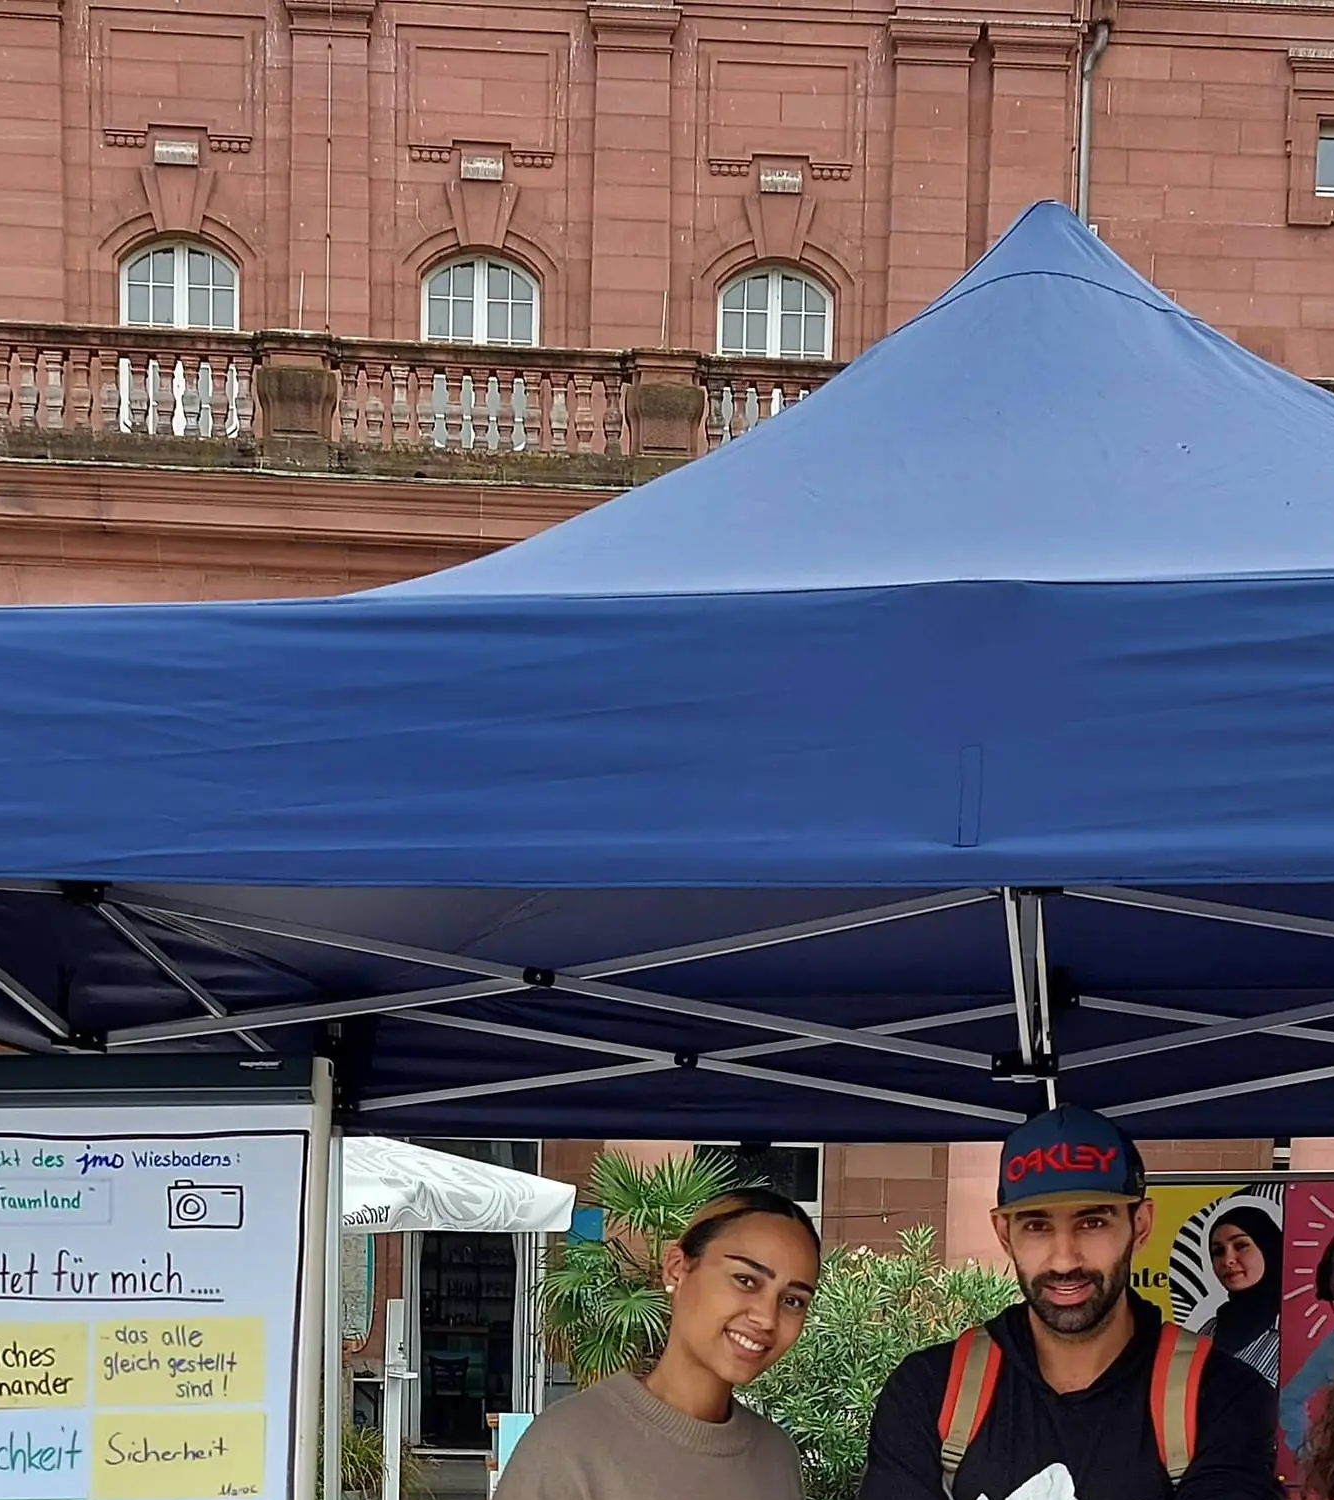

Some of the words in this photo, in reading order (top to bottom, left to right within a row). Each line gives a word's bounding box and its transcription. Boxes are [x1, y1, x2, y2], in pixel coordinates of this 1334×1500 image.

[32, 1149, 64, 1167] des
[1006, 1143, 1117, 1183] OAKLEY
[53, 1250, 96, 1295] für
[115, 1326, 148, 1344] das
[162, 1325, 202, 1347] alle
[104, 1352, 160, 1378] gleich
[168, 1354, 237, 1380] gestellt
[177, 1378, 213, 1397] sind
[105, 1432, 227, 1465] Sicherheit
